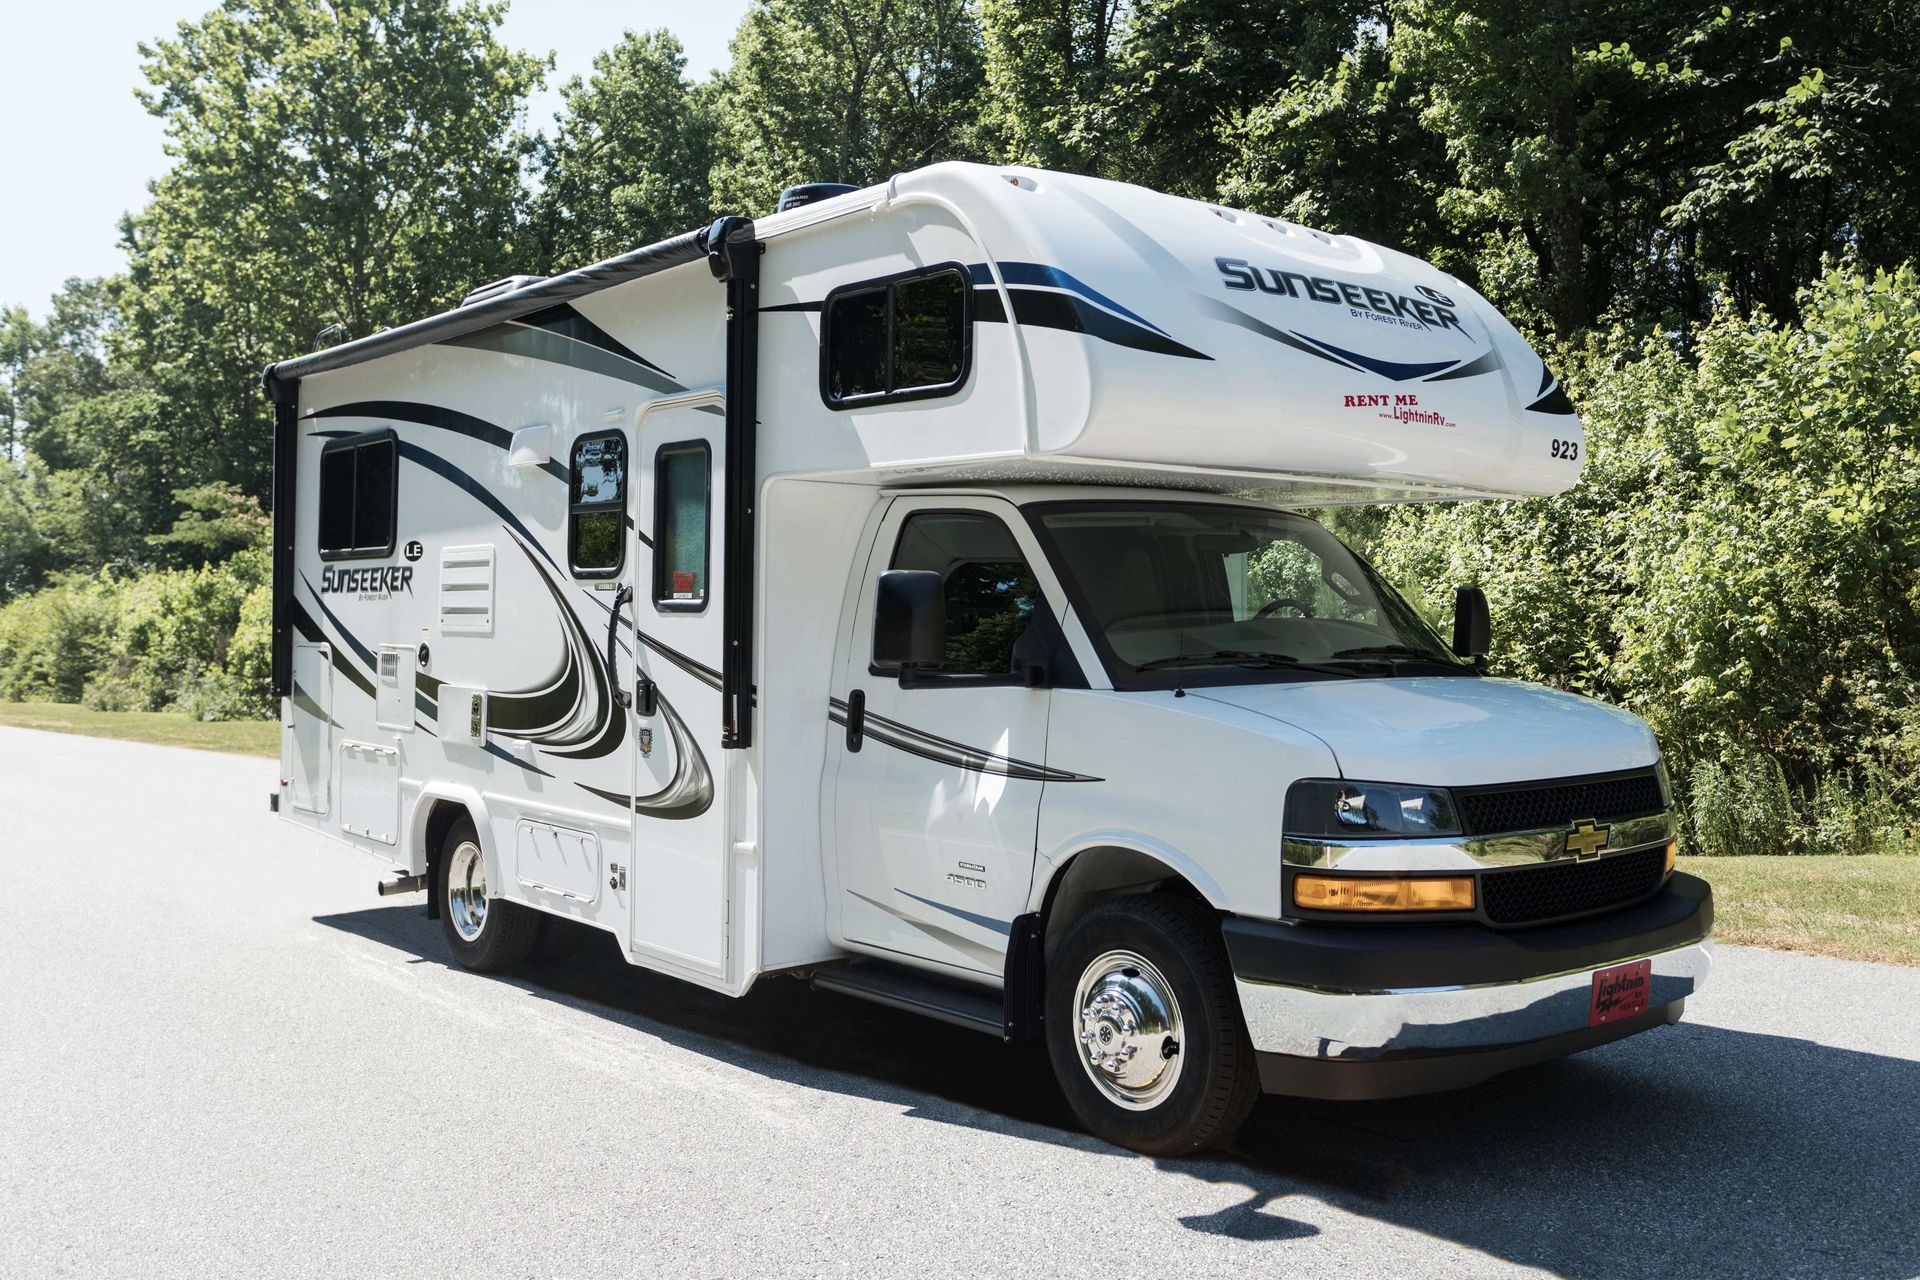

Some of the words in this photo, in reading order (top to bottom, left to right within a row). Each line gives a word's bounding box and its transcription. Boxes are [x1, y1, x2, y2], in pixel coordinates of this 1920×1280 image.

[1214, 256, 1477, 344] SUNSEEKER
[1416, 286, 1453, 305] LE
[1350, 308, 1363, 318] BY
[1365, 311, 1397, 325] FOREST
[1399, 318, 1423, 330] RIVER
[1344, 395, 1389, 407] RENT
[1395, 395, 1418, 406] ME
[1551, 438, 1578, 461] 923
[406, 544, 422, 557] LE
[321, 565, 414, 600] SUNSEEKER
